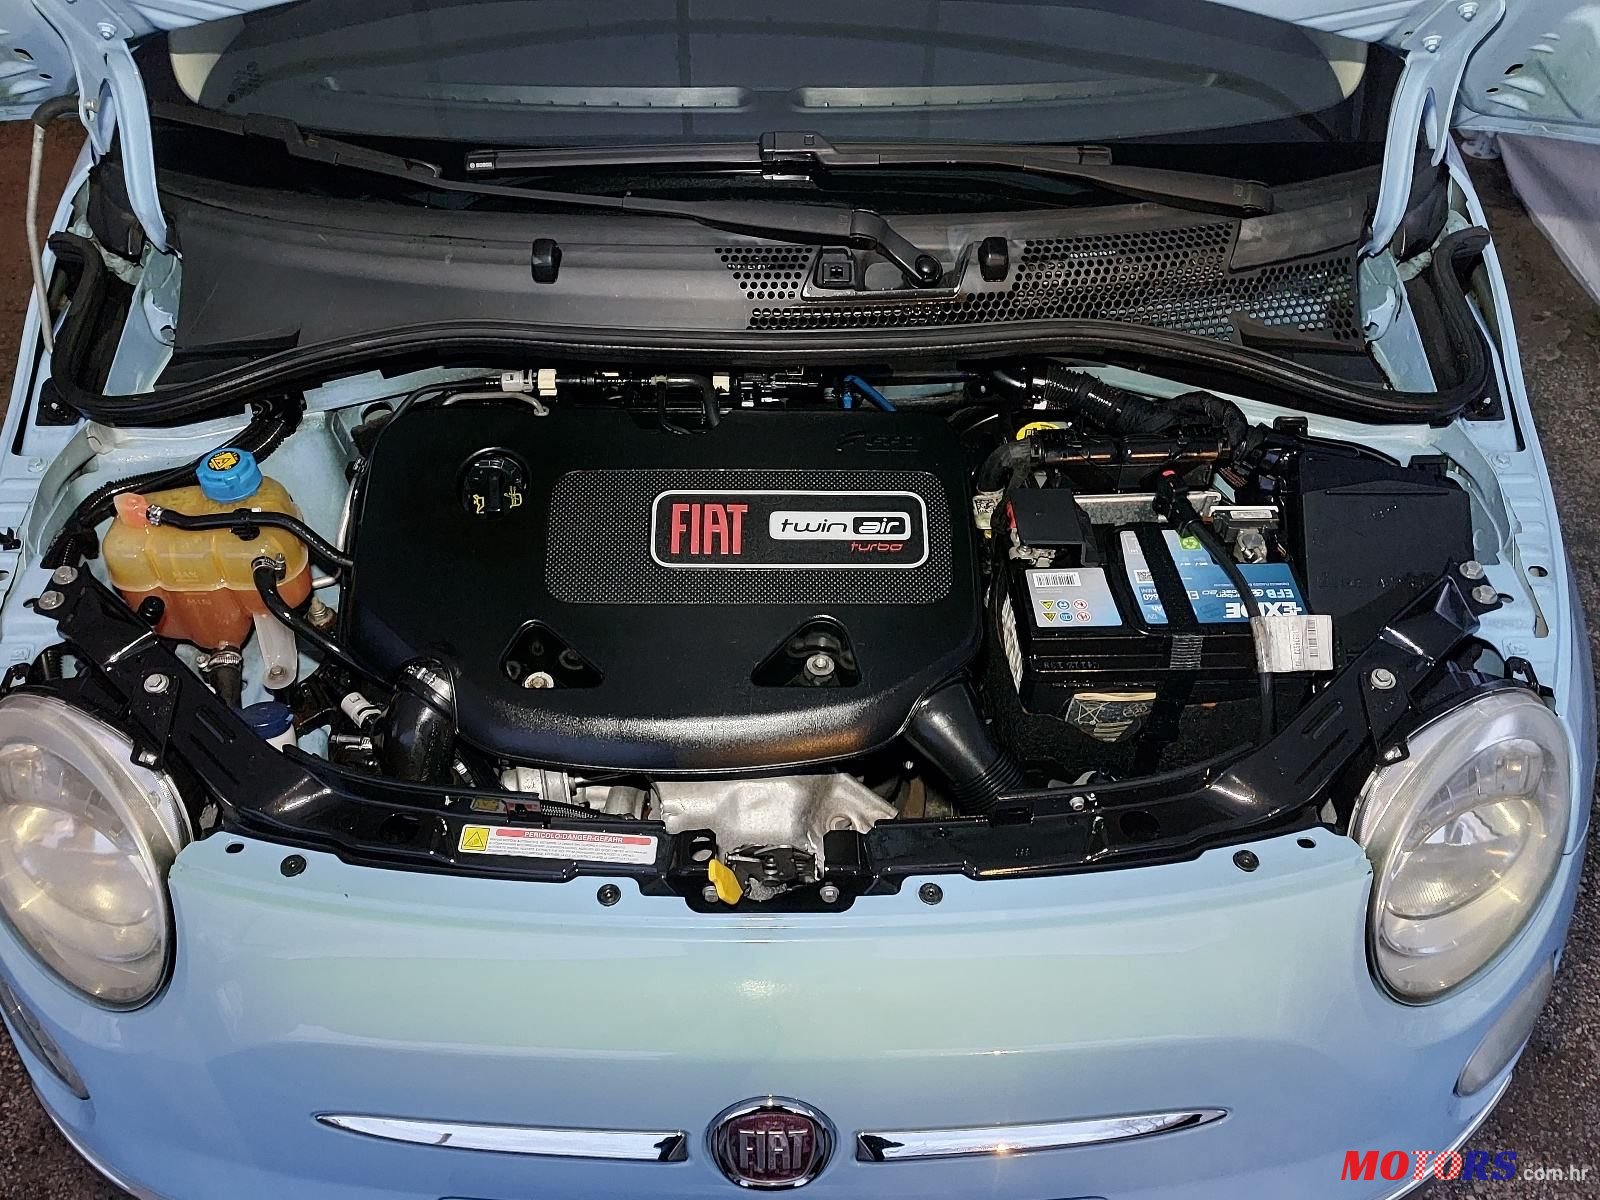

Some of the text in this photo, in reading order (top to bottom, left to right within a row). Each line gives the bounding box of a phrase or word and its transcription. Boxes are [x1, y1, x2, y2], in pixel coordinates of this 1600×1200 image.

[671, 503, 748, 555] FIAT
[781, 517, 900, 534] twin air
[850, 541, 904, 552] turbo
[1266, 588, 1295, 598] EFB
[738, 1128, 809, 1170] FIAT
